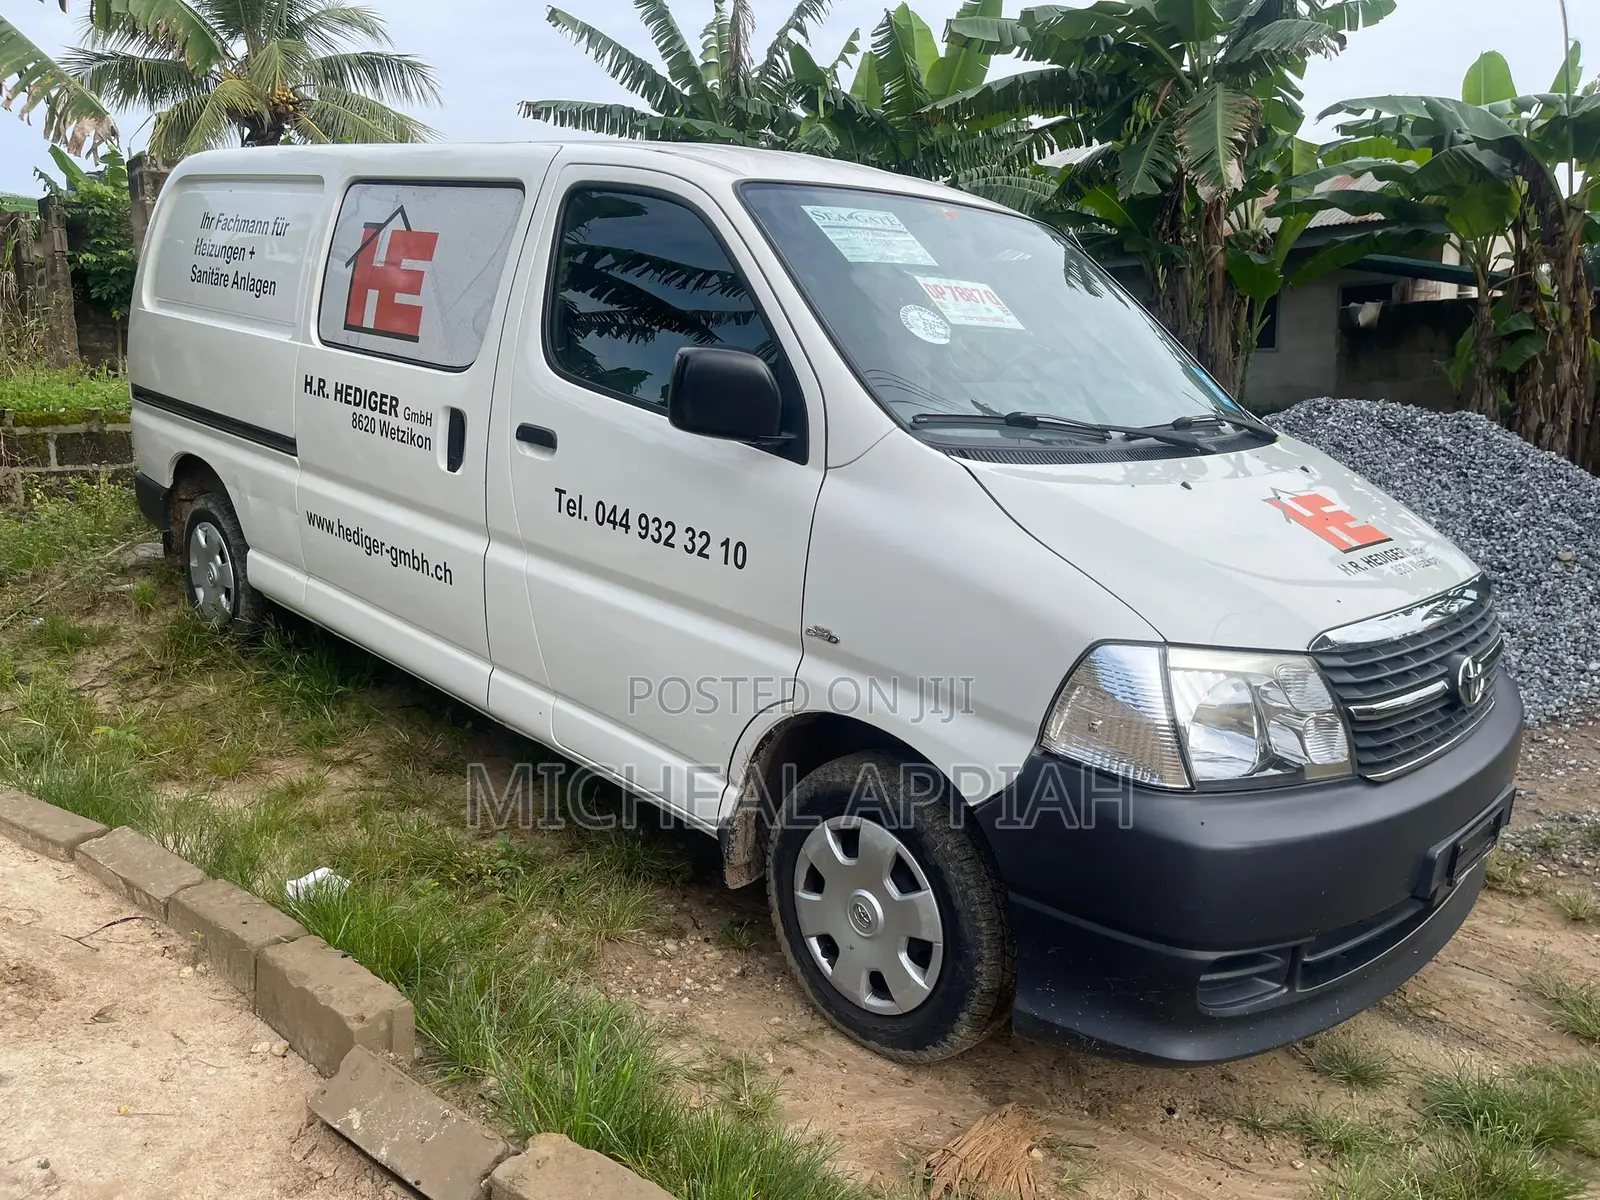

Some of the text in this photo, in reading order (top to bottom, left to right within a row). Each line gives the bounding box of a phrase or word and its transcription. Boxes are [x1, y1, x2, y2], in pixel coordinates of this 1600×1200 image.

[200, 211, 290, 237] Ihr Fachmann für
[194, 237, 246, 265] Heizungen
[190, 263, 277, 299] Sanitäre Anlagen
[303, 373, 433, 428] H.R. HEDIGER GmbH
[351, 411, 433, 452] 8620 Wetzikon
[306, 510, 454, 586] www.hediger-gmbh.ch
[554, 487, 748, 571] Tel. 044 932 32 10
[1360, 546, 1411, 569] HEDIGER
